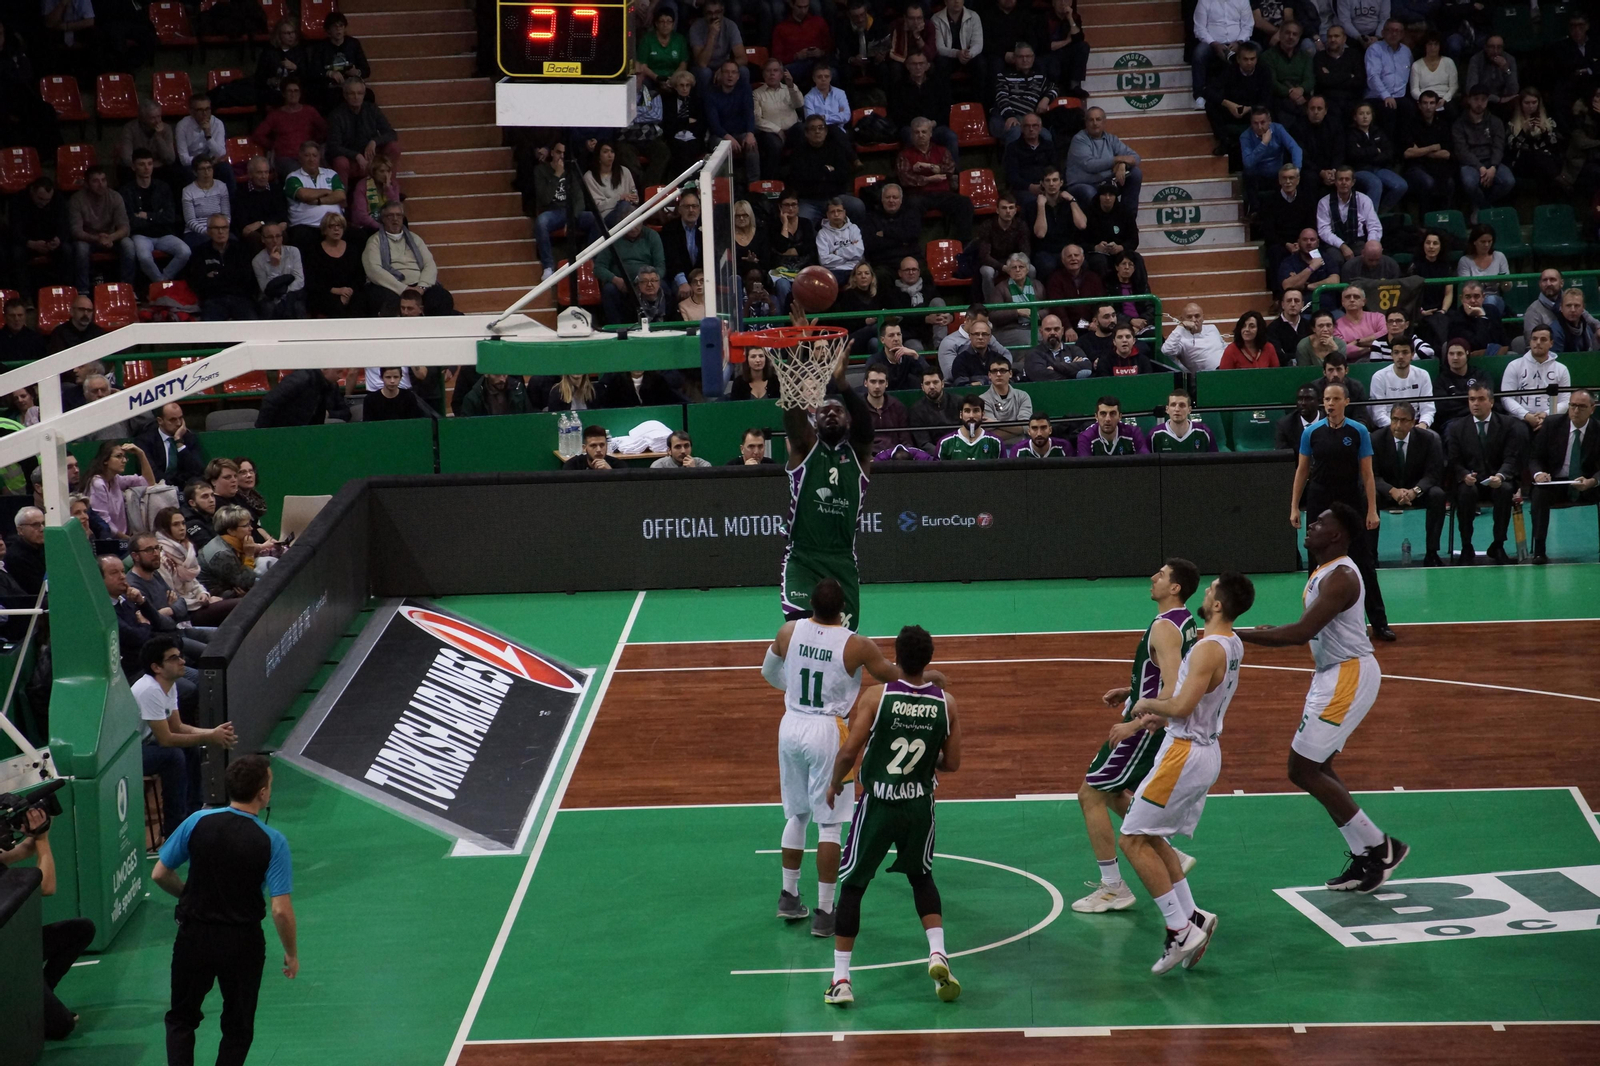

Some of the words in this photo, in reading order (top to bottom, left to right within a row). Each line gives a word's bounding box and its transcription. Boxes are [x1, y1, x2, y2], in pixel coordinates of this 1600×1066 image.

[545, 63, 579, 73] Bodet
[1119, 53, 1148, 64] LIMOGES
[1158, 187, 1188, 199] LIMOGES
[1379, 289, 1401, 310] 87
[128, 374, 188, 411] MARTY
[642, 517, 719, 540] OFFICIAL
[724, 515, 783, 538] MOTOR
[921, 514, 976, 528] EuroCup
[798, 643, 834, 662] TAYLOR
[408, 647, 515, 742] AIRLINES
[798, 667, 825, 708] 11
[891, 700, 939, 719] ROBERTS
[363, 710, 481, 811] TURKISH
[885, 736, 927, 776] 22
[112, 847, 138, 894] LIMOGES
